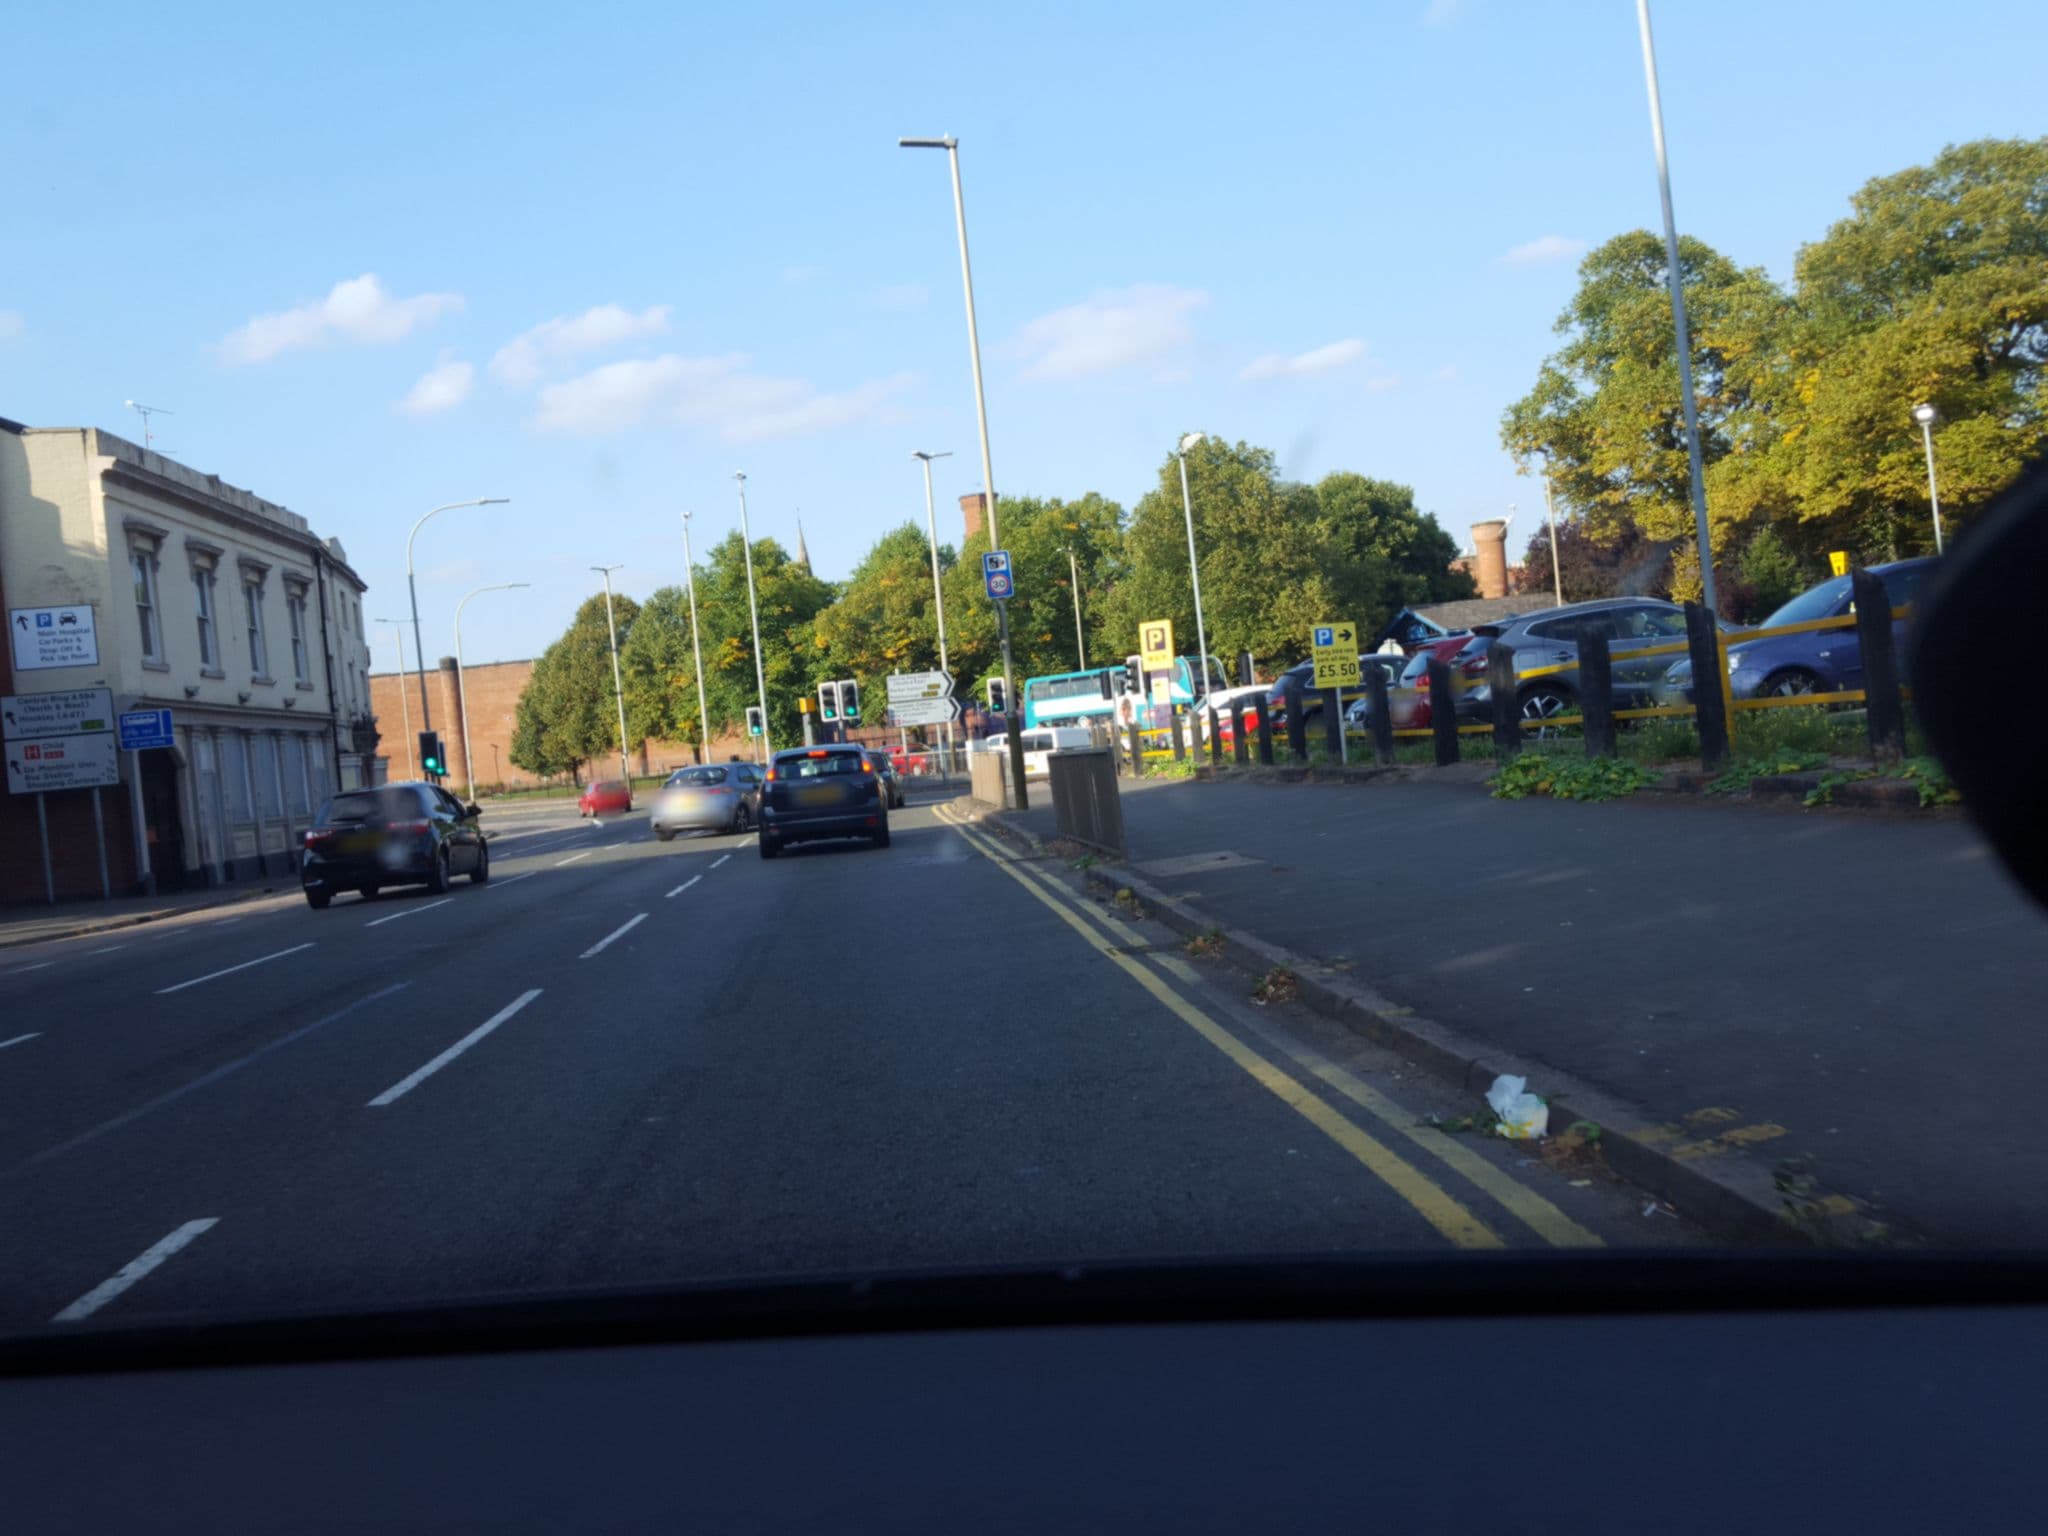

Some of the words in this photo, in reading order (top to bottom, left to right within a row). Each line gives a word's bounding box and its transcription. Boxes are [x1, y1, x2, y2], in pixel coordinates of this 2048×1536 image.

[992, 580, 1006, 589] 30
[40, 614, 49, 626] P
[59, 627, 90, 635] Hospital
[1317, 629, 1330, 645] P
[1149, 629, 1163, 650] P
[1318, 662, 1357, 678] £5.50
[17, 695, 47, 704] Central
